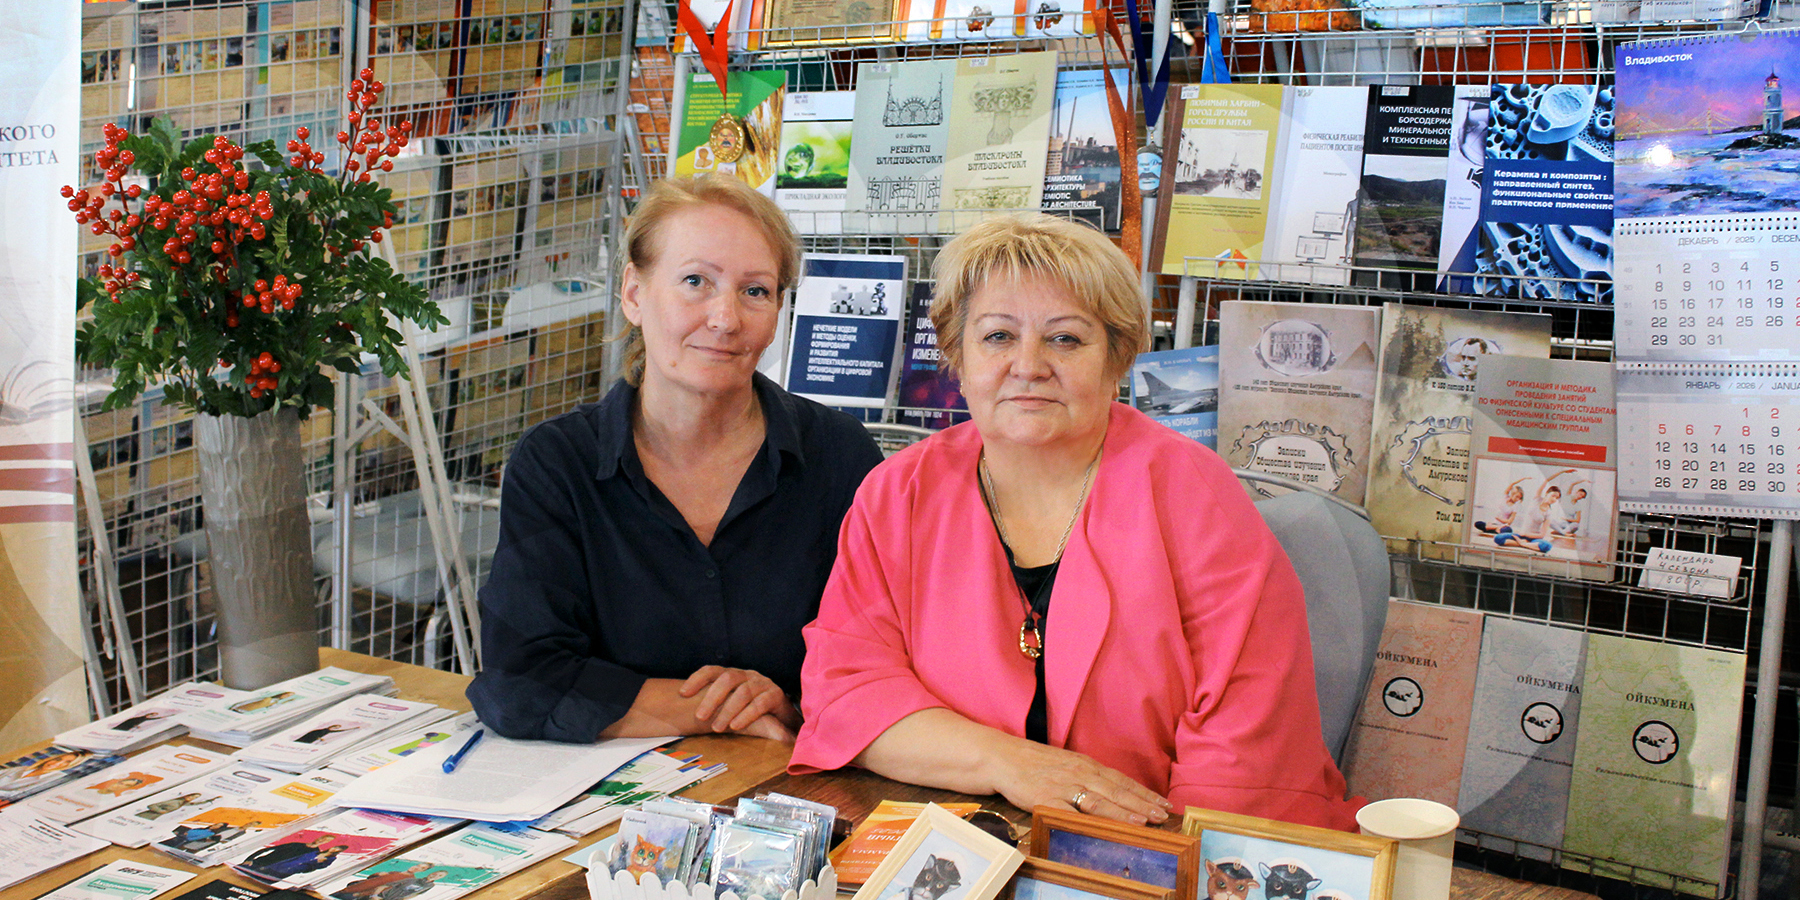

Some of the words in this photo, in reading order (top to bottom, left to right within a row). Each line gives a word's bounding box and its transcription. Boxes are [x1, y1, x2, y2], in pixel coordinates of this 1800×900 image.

[1625, 52, 1693, 65] Владивосток
[1213, 109, 1247, 117] ДРУЖБЫ
[1389, 127, 1452, 135] МИНЕРАЛЬНОГО
[1391, 137, 1447, 145] ТЕХНОГЕННЫХ
[876, 155, 943, 165] ВЛАДИВОСТОКА
[968, 160, 1027, 171] ВЛАДИВОСТОКА
[1494, 169, 1539, 180] Керамика
[1550, 172, 1601, 180] композиты
[1045, 183, 1085, 191] РХИТЕКТУРЫ
[1493, 180, 1560, 190] направленный
[1492, 189, 1571, 200] функциональные
[1574, 191, 1614, 201] свойства
[1050, 200, 1097, 208] ARCHITECTURE
[1491, 200, 1553, 209] практическое
[1555, 201, 1614, 211] применение
[1678, 237, 1718, 246] ДЕКАБРЬ
[1656, 264, 1662, 274] 1
[1683, 263, 1691, 273] 2
[1711, 262, 1720, 273] 3
[1740, 262, 1749, 272] 4
[1770, 261, 1779, 271] 5
[1655, 281, 1663, 292] 8
[1683, 281, 1691, 291] 9
[1708, 280, 1725, 291] 10
[1737, 280, 1752, 290] 11
[1766, 279, 1783, 290] 12
[1652, 299, 1668, 309] 15
[1680, 298, 1695, 309] 16
[1708, 298, 1724, 309] 17
[1737, 298, 1753, 309] 18
[1766, 297, 1783, 308] 19
[1651, 317, 1668, 327] 22
[1679, 317, 1695, 327] 23
[1707, 316, 1724, 327] 24
[1736, 316, 1753, 327] 25
[1765, 316, 1783, 327] 26
[1651, 335, 1668, 345] 29
[1679, 335, 1696, 345] 30
[1707, 334, 1722, 345] 31
[1507, 380, 1553, 390] ОРГАНИЗАЦИЯ
[1560, 384, 1597, 394] МЕТОДИКА
[1685, 381, 1720, 389] ЯНВАРЬ
[1515, 391, 1556, 400] ПРОВЕДЕНИЯ
[1558, 393, 1586, 402] ЗАНЯТИЙ
[1479, 397, 1488, 405] ПО
[1490, 398, 1532, 409] ФИЗИЧЕСКОЙ
[1534, 401, 1564, 411] КУЛЬТУРЕ
[1578, 405, 1616, 415] СТУДЕНТАМ
[1496, 409, 1544, 420] ОТНЕСЕННЫМИ
[1552, 413, 1603, 424] СПЕЦИАЛЬНЫМ
[1742, 408, 1748, 418] 1
[1770, 408, 1780, 419] 2
[1507, 419, 1558, 431] МЕДИЦИНСКИМ
[1559, 423, 1590, 433] ГРУППАМ
[1658, 424, 1667, 434] 5
[1685, 424, 1694, 435] 6
[1713, 425, 1722, 435] 7
[1741, 426, 1751, 436] 8
[1771, 426, 1780, 437] 9
[1278, 446, 1306, 457] Записки
[1655, 442, 1671, 452] 12
[1682, 443, 1698, 453] 13
[1710, 443, 1726, 454] 14
[1739, 444, 1755, 455] 15
[1768, 445, 1785, 455] 16
[1257, 456, 1291, 468] Общества
[1294, 461, 1326, 471] изучения
[1423, 456, 1460, 469] Общества
[1655, 460, 1671, 470] 19
[1682, 460, 1699, 471] 20
[1710, 461, 1725, 472] 21
[1738, 462, 1755, 473] 22
[1767, 463, 1785, 474] 23
[1655, 477, 1671, 488] 26
[1682, 478, 1698, 488] 27
[1710, 479, 1727, 490] 28
[1738, 480, 1756, 491] 29
[1767, 481, 1785, 492] 30
[1436, 511, 1450, 521] Том
[1376, 651, 1438, 668] ОЙКУМЕНА
[1516, 674, 1580, 694] ОЙКУМЕНА
[1625, 692, 1695, 711] ОЙКУМЕНА
